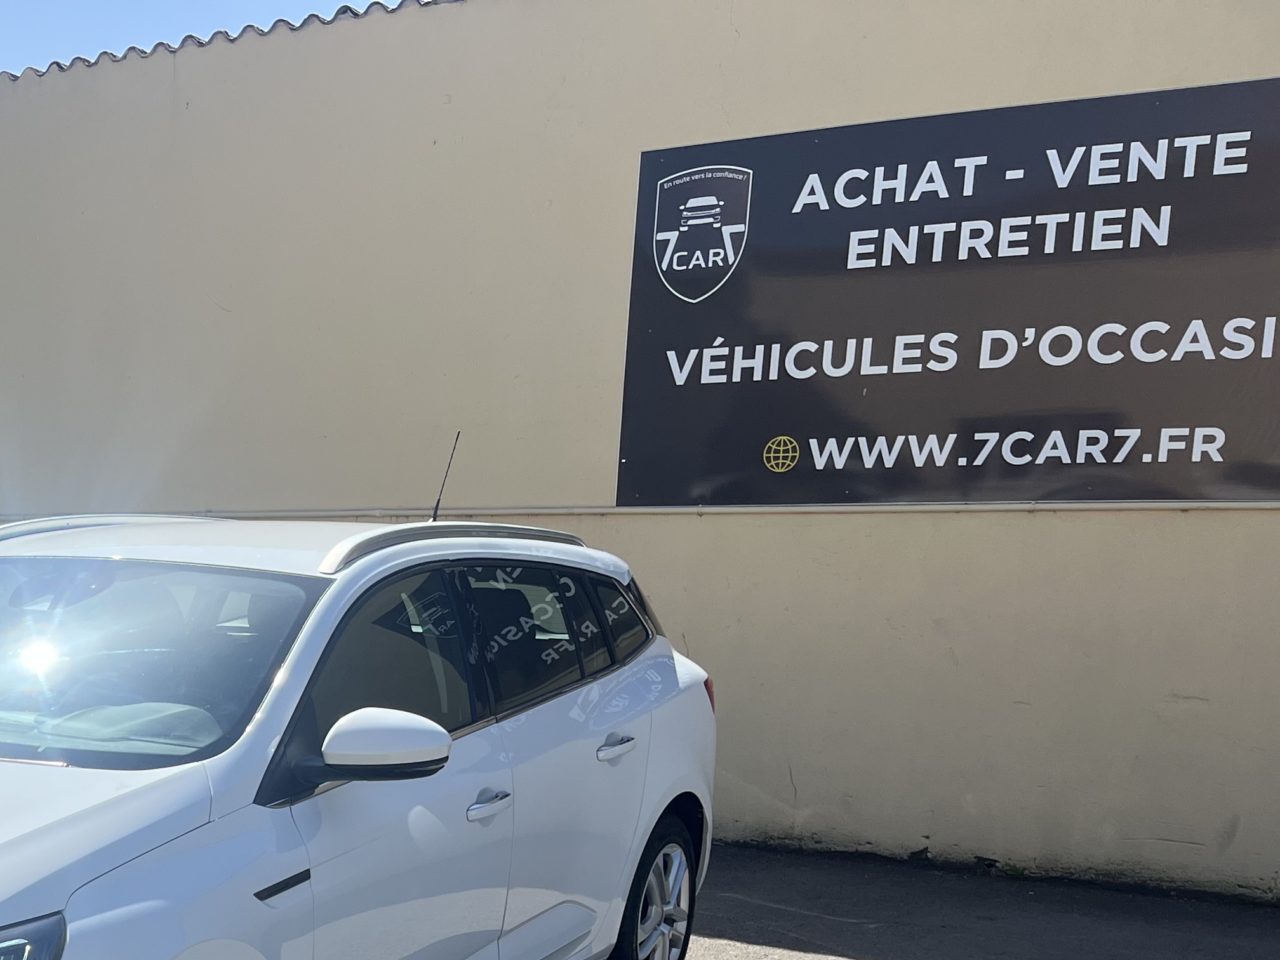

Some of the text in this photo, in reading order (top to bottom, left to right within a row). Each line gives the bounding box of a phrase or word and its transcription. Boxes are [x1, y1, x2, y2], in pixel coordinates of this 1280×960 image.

[673, 176, 691, 186] route
[791, 155, 988, 214] ACHAT
[1045, 130, 1252, 188] VENTE
[847, 205, 1172, 270] ENTRETIEN
[666, 332, 959, 386] VÉHICULES
[808, 427, 1226, 470] WWW.7CAR7.FR
